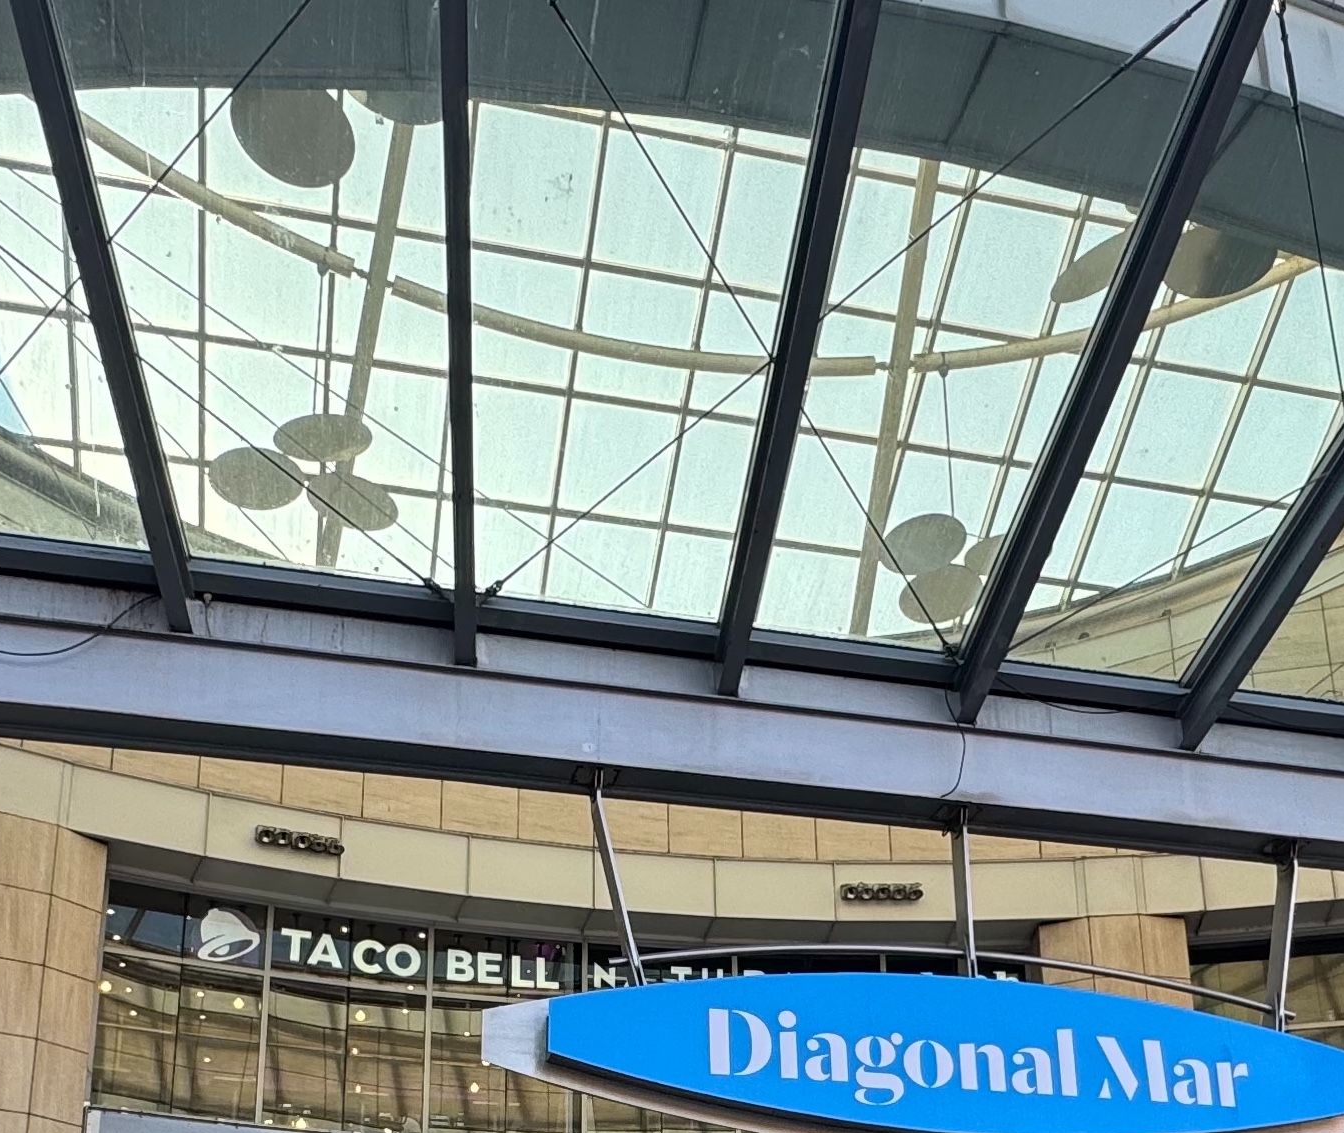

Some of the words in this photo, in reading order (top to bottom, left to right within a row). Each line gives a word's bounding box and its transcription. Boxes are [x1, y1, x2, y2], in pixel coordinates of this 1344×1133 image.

[281, 927, 422, 977] TACO
[446, 948, 560, 990] BELL
[708, 1006, 1079, 1105] Diagonal
[1095, 1034, 1249, 1108] Mar
